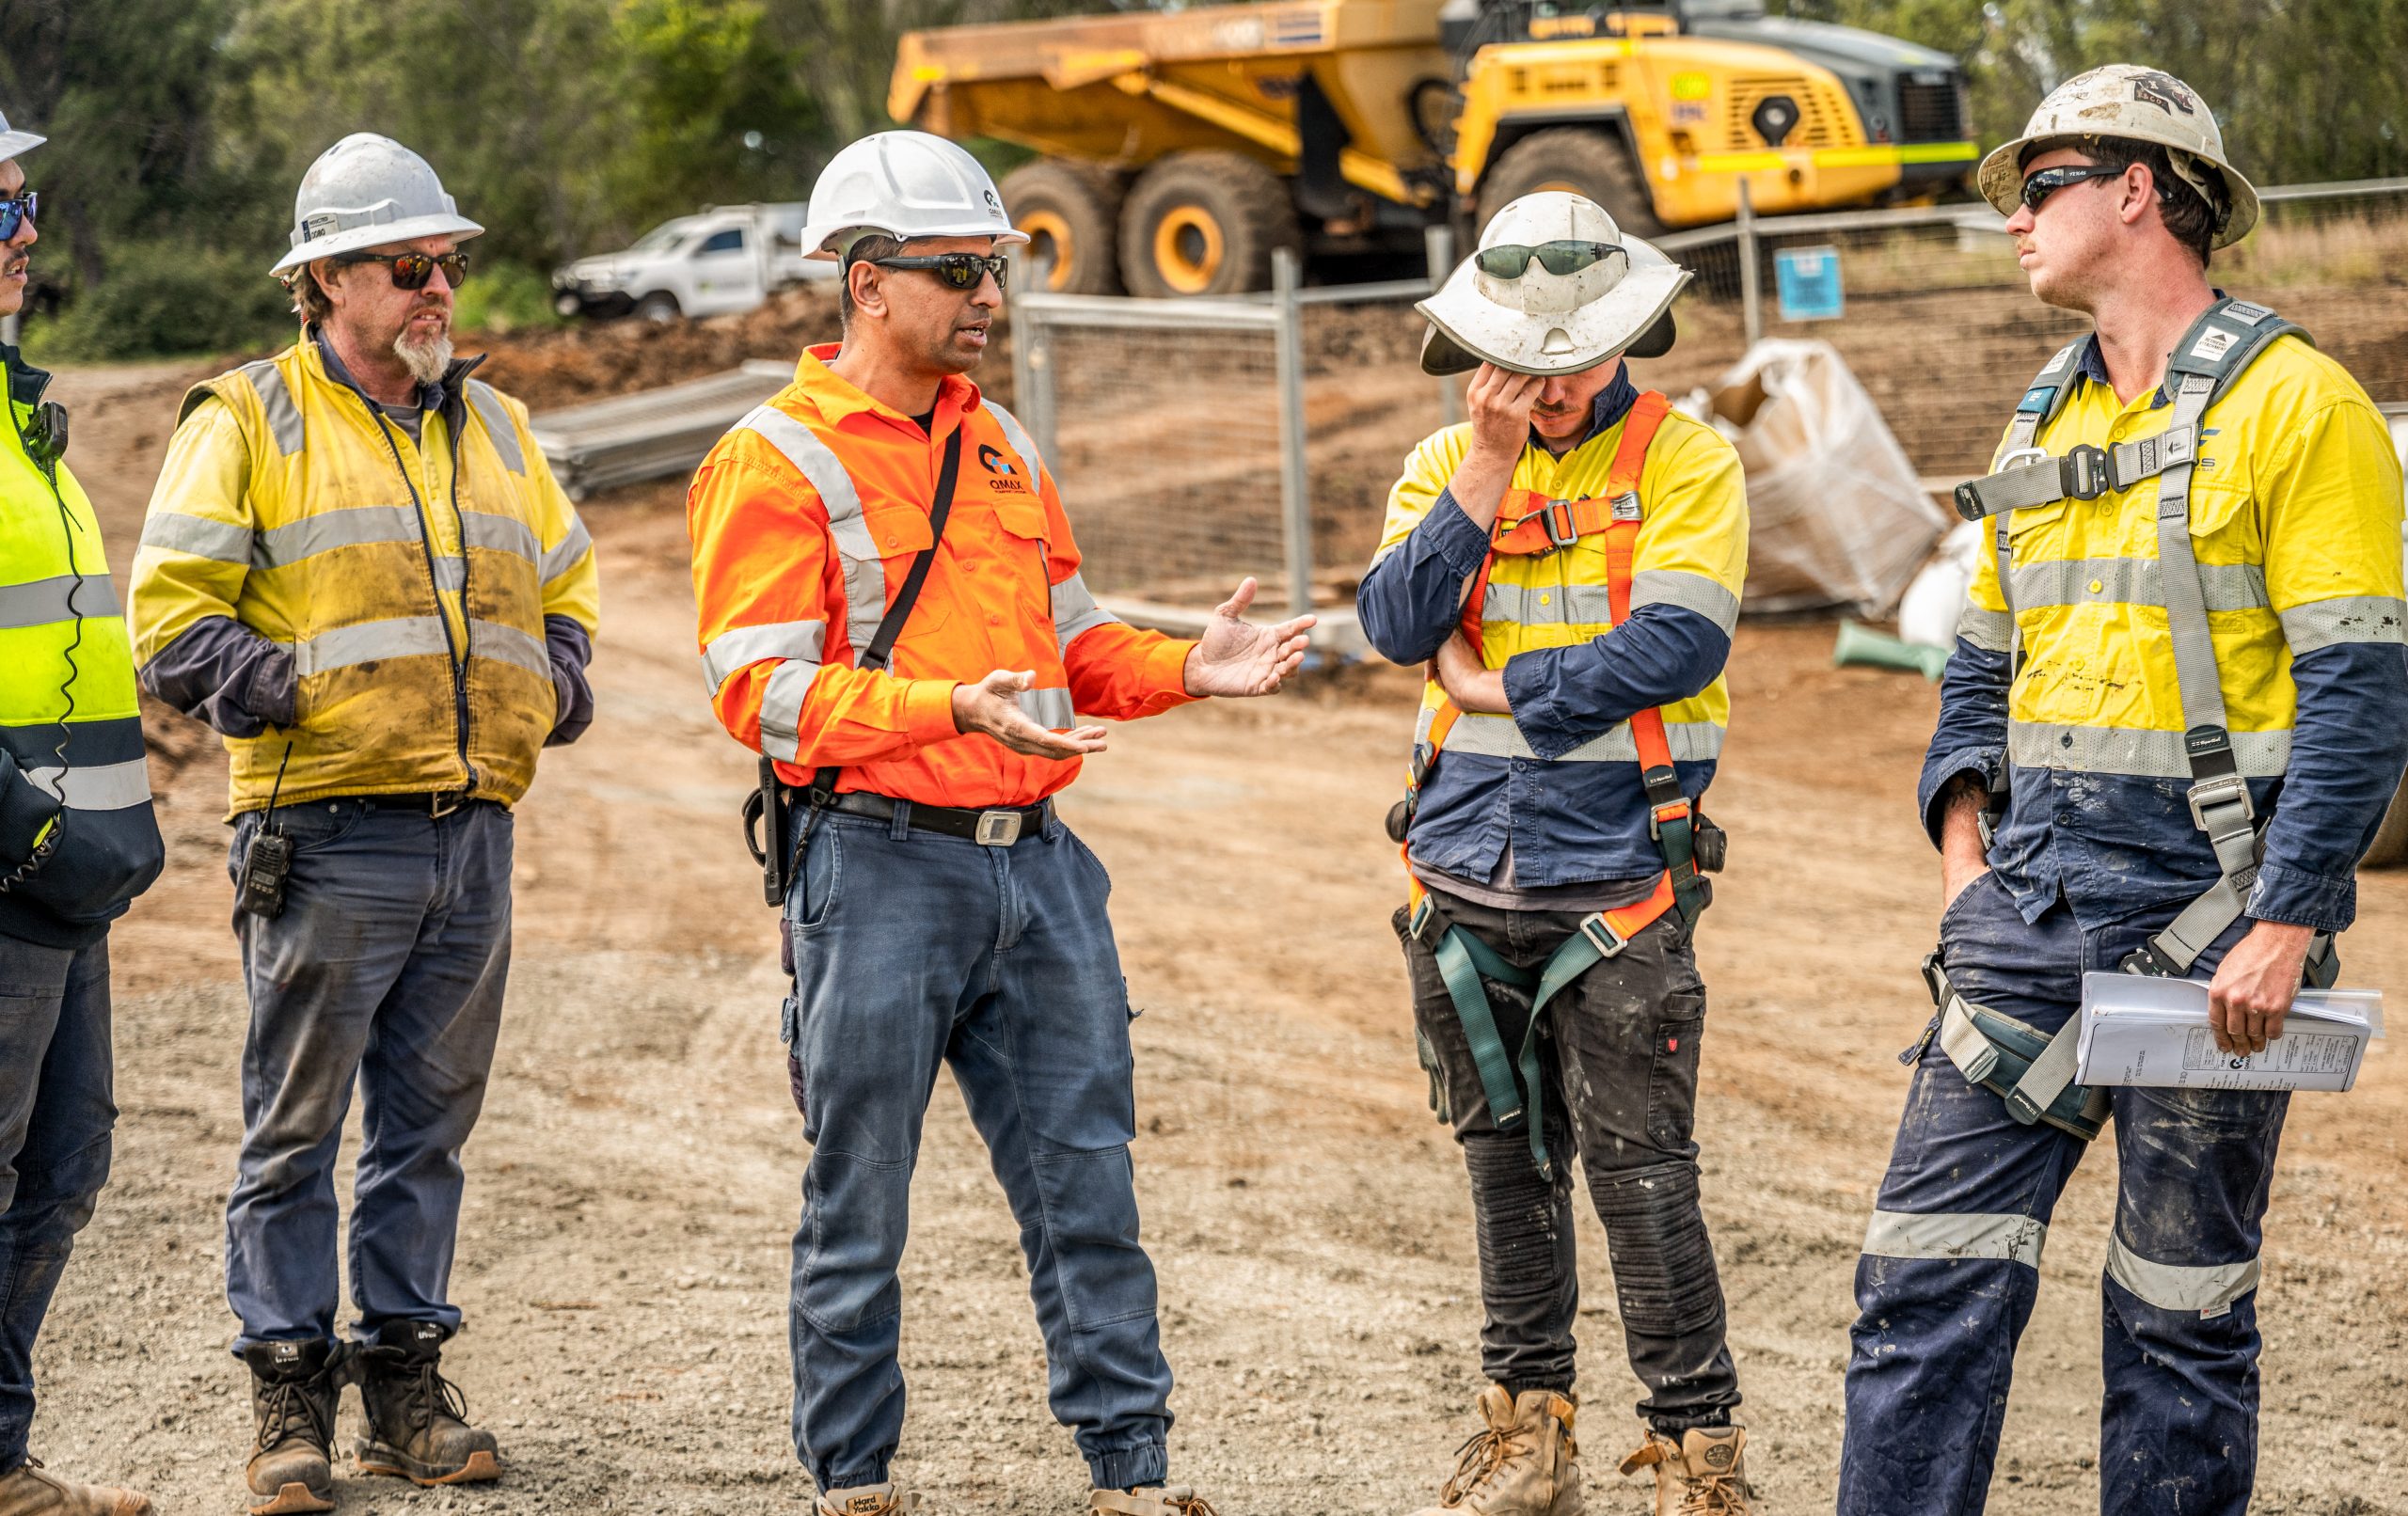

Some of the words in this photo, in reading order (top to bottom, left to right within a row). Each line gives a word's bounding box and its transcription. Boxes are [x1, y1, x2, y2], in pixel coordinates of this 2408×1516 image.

[990, 480, 1023, 490] QMAX
[853, 1494, 877, 1507] Hard
[853, 1504, 880, 1515] Yakka
